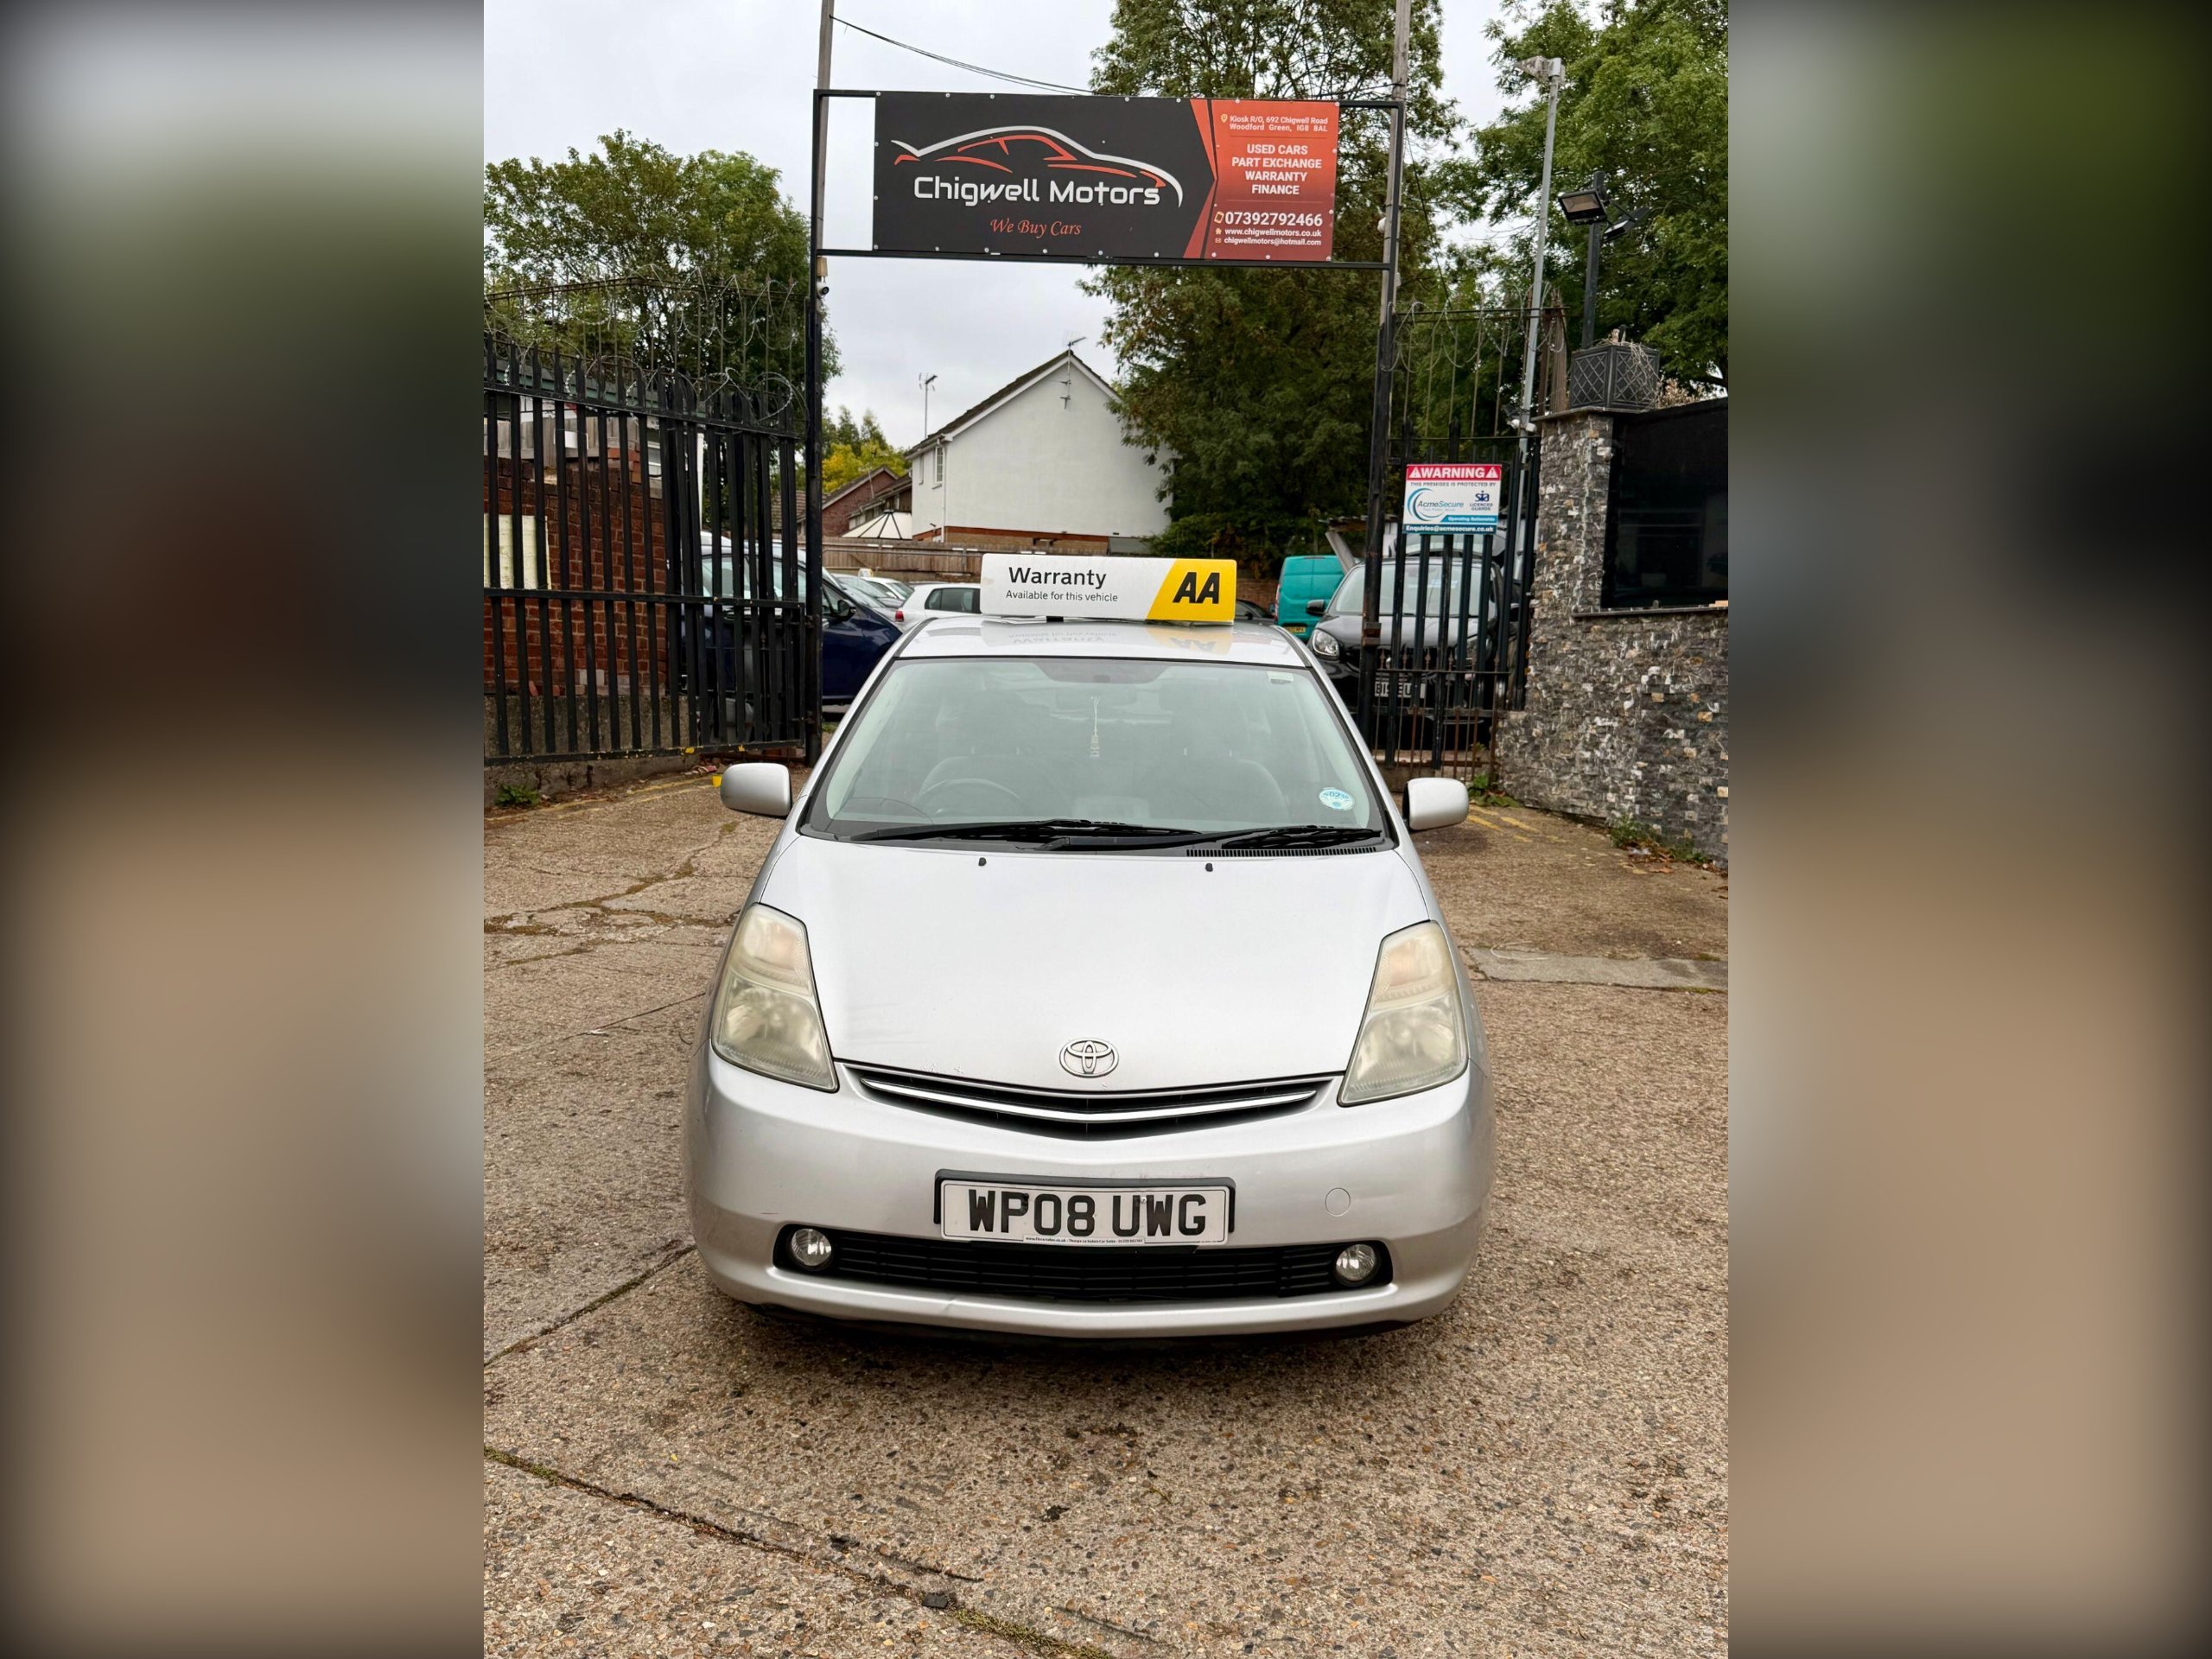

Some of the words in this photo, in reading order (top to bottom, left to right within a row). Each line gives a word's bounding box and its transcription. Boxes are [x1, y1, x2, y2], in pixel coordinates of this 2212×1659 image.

[1280, 117, 1309, 126] Chigwell
[1268, 124, 1293, 132] Green,
[1247, 143, 1275, 154] USED
[1278, 144, 1308, 155] CARS
[1232, 156, 1261, 168] PART
[1262, 157, 1322, 168] EXCHANGE
[1245, 170, 1307, 181] WARRANTY
[913, 175, 1040, 207] Chigwell
[1049, 180, 1160, 206] Motors
[1251, 184, 1300, 195] FINANCE
[1224, 212, 1323, 226] 07392792466
[990, 218, 1014, 234] We
[1018, 219, 1046, 239] Buy
[1050, 221, 1082, 237] Cars
[1224, 227, 1322, 238] www.chigwellmotors.co.uk
[1224, 238, 1322, 246] chigwellmotors@hotmail.com
[1421, 467, 1485, 479] WARNING
[1008, 566, 1107, 589] Warranty
[1173, 571, 1220, 605] AA
[1006, 589, 1048, 601] Available
[1051, 590, 1064, 601] for
[1066, 591, 1083, 601] this
[1084, 592, 1118, 602] vehicle
[968, 1189, 1096, 1237] WP08
[1112, 1194, 1206, 1237] UWG
